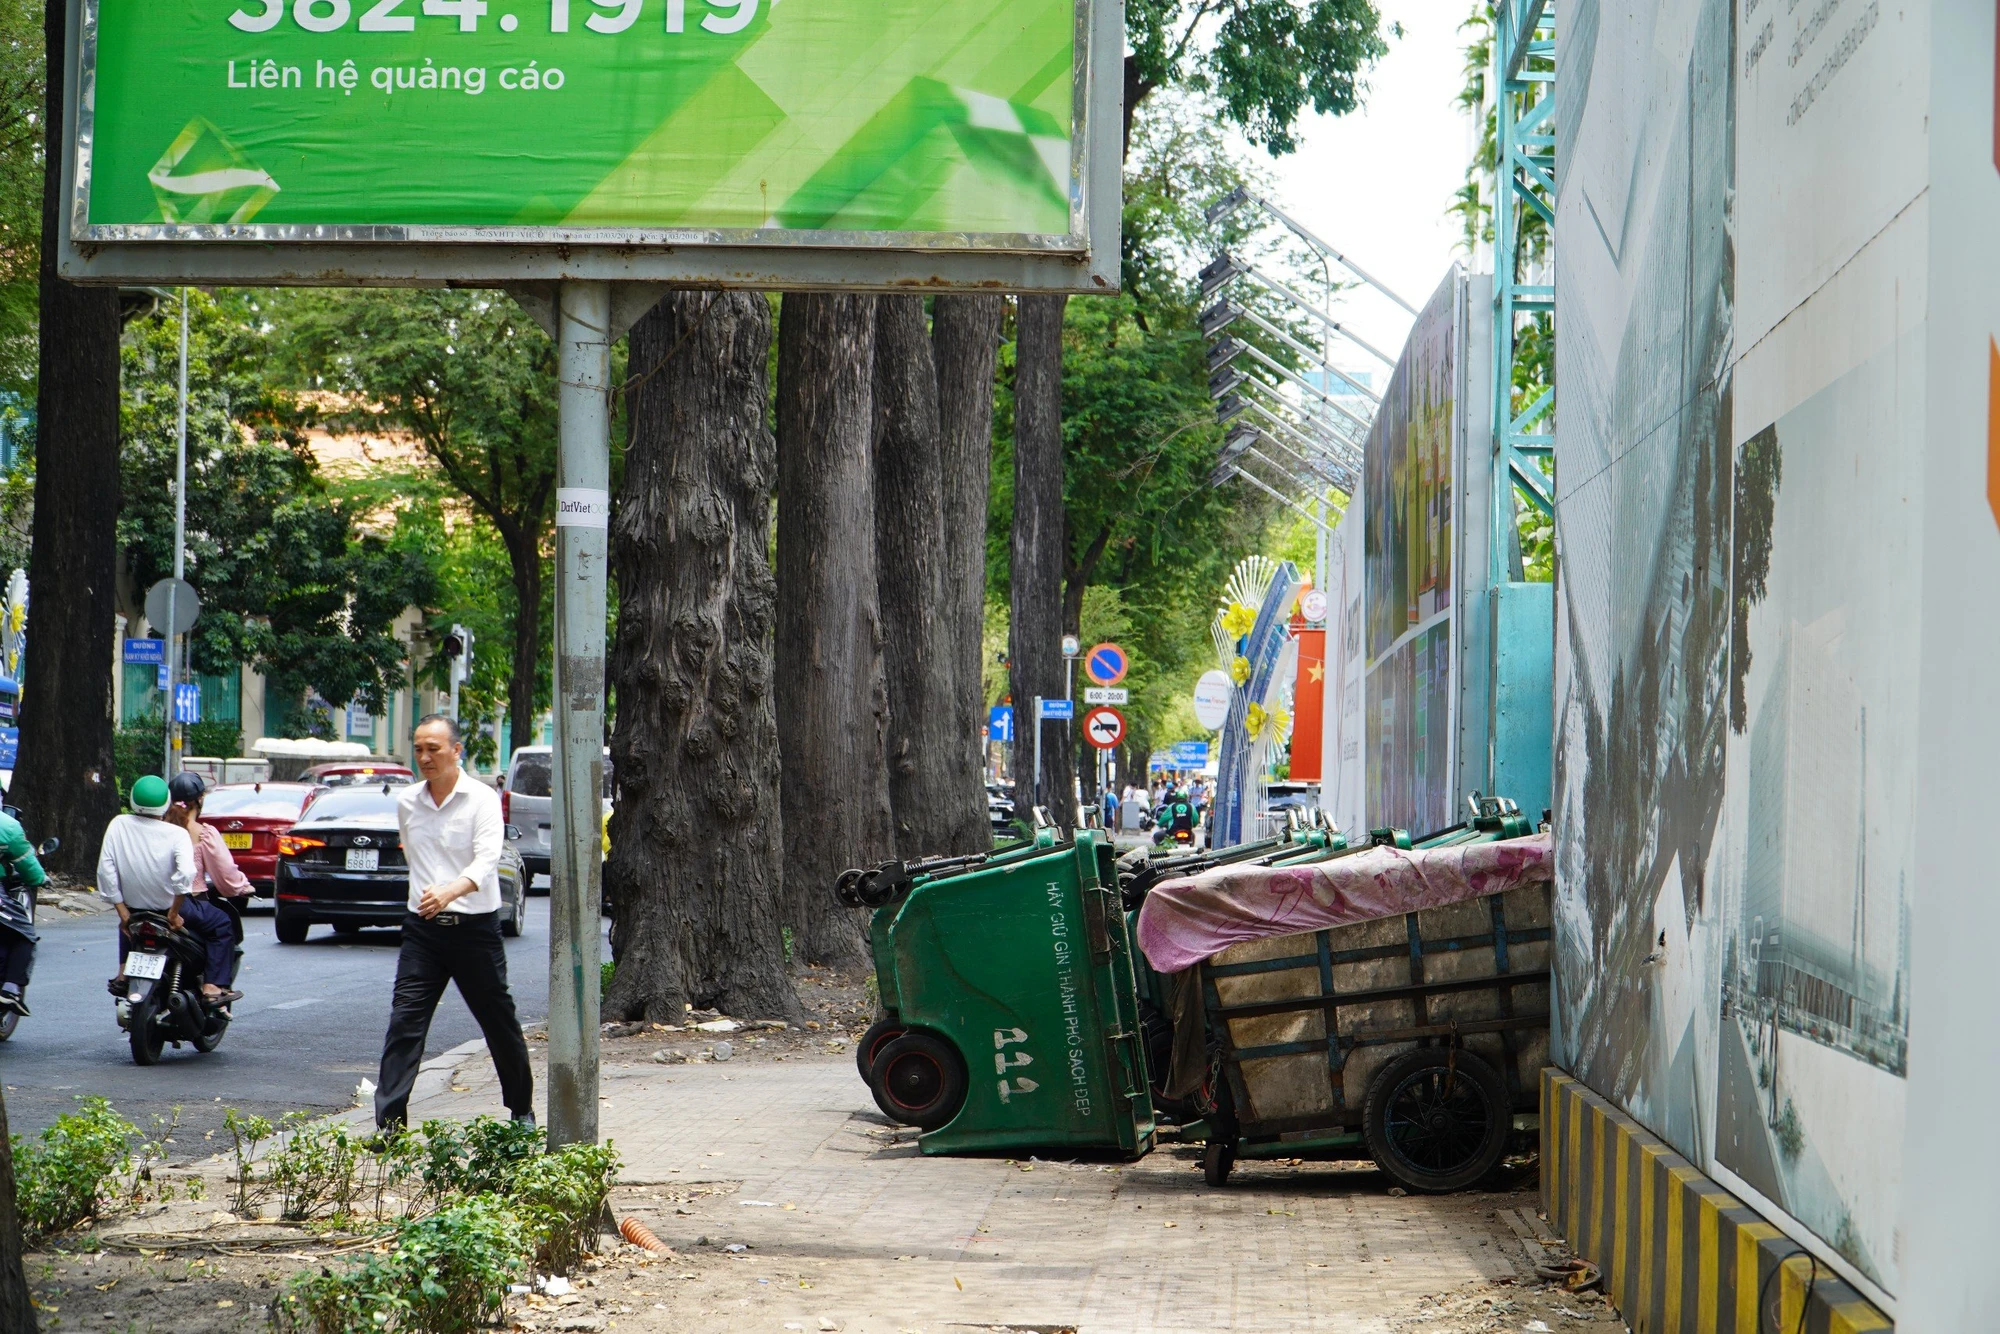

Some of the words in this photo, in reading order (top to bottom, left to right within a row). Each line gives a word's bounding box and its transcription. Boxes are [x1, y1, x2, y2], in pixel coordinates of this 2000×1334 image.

[227, 60, 301, 88] Liên
[315, 60, 358, 95] hệ
[370, 58, 486, 94] quảng
[498, 60, 565, 90] cáo
[1089, 691, 1102, 700] 6:00
[1107, 692, 1124, 701] 20:00
[354, 849, 372, 859] 51F
[1046, 881, 1064, 908] HÃY
[1050, 912, 1069, 937] GIỮ
[1054, 941, 1073, 965] GÌN
[1058, 967, 1077, 1014] THÀNH
[1064, 1017, 1085, 1046] PHỐ
[1067, 1049, 1087, 1086] SẠCH
[1073, 1088, 1091, 1116] ĐẸP
